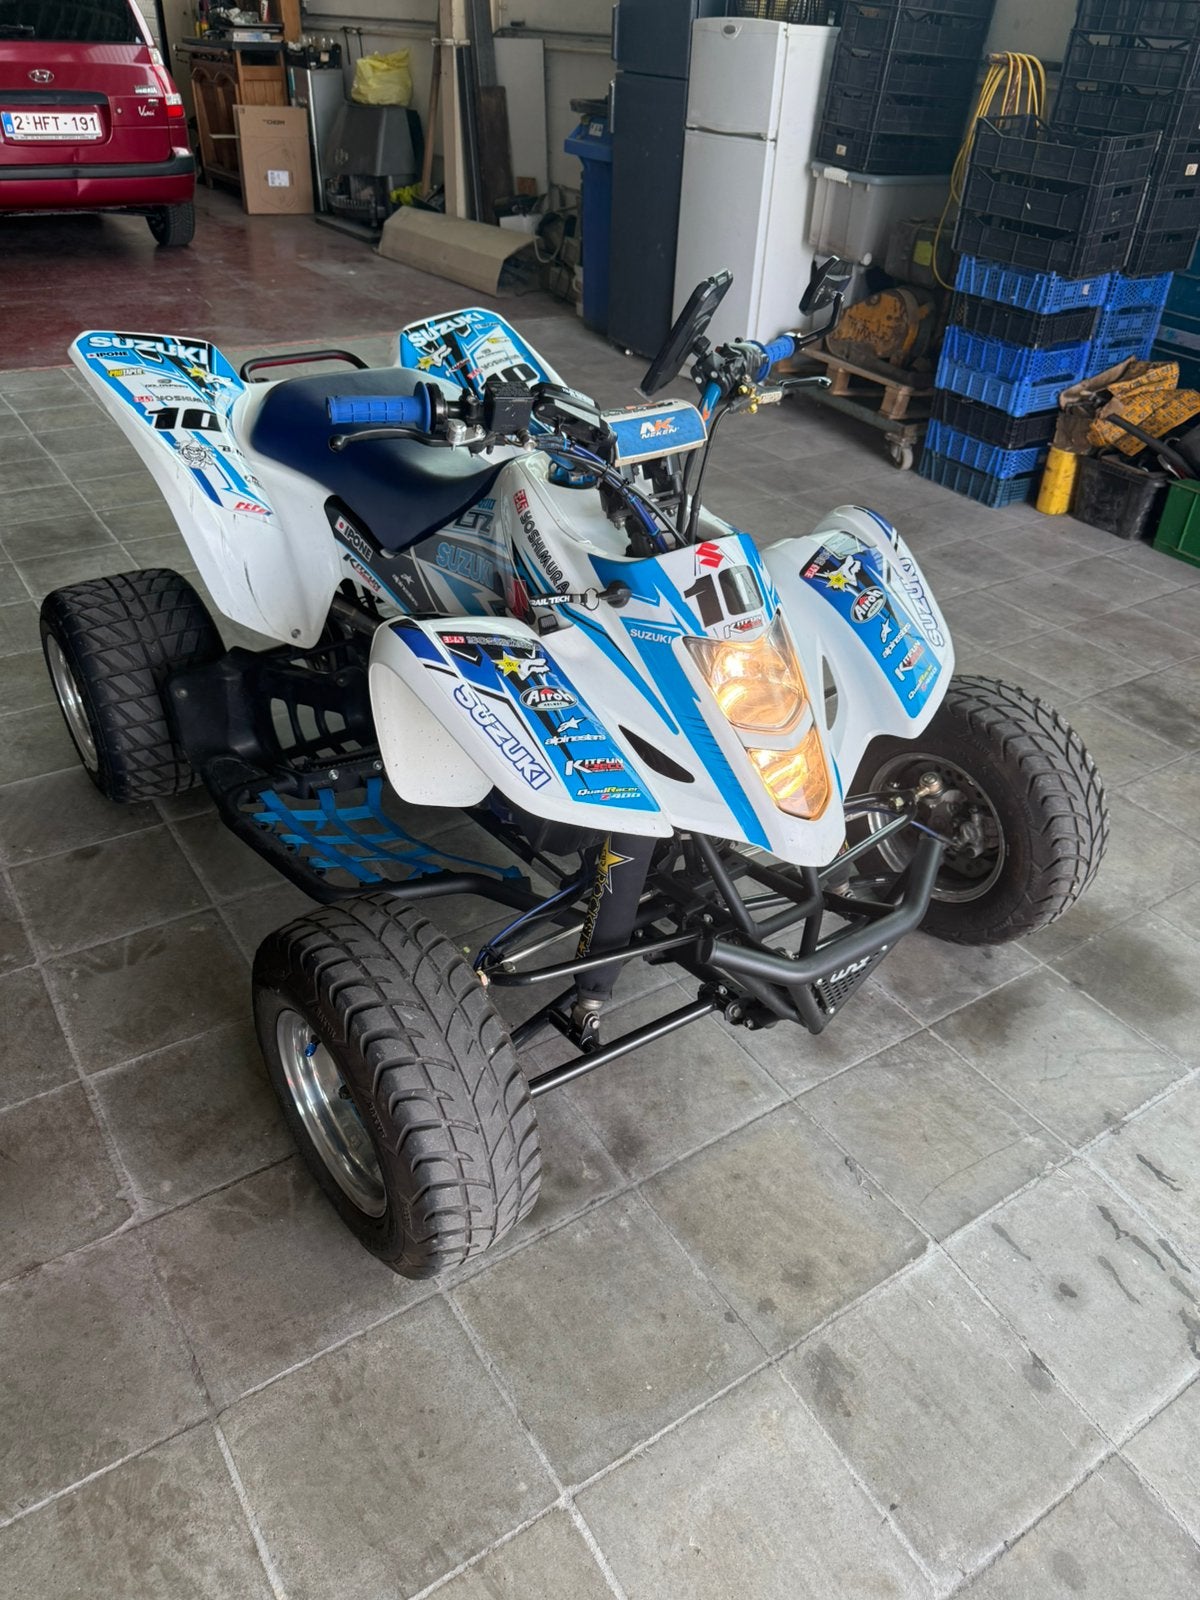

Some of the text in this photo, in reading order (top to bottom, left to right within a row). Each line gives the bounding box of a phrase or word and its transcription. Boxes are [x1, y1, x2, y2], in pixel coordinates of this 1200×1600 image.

[408, 312, 485, 348] SUZUKI
[89, 336, 208, 364] SUZUKI
[148, 407, 222, 432] 10
[641, 427, 678, 439] NEKEN
[344, 525, 373, 561] IPONE
[520, 510, 570, 594] YOSHIMURA
[435, 541, 494, 590] SUZUKI
[549, 595, 570, 605] TECH
[683, 564, 764, 628] 10
[854, 589, 884, 621] Airoh
[893, 557, 945, 647] SUZUKI
[629, 628, 672, 644] SUZUKI
[526, 686, 575, 706] Airoh
[453, 684, 551, 791] SUZUKI
[545, 733, 606, 746] alpinestars
[577, 786, 640, 797] QuadRacer
